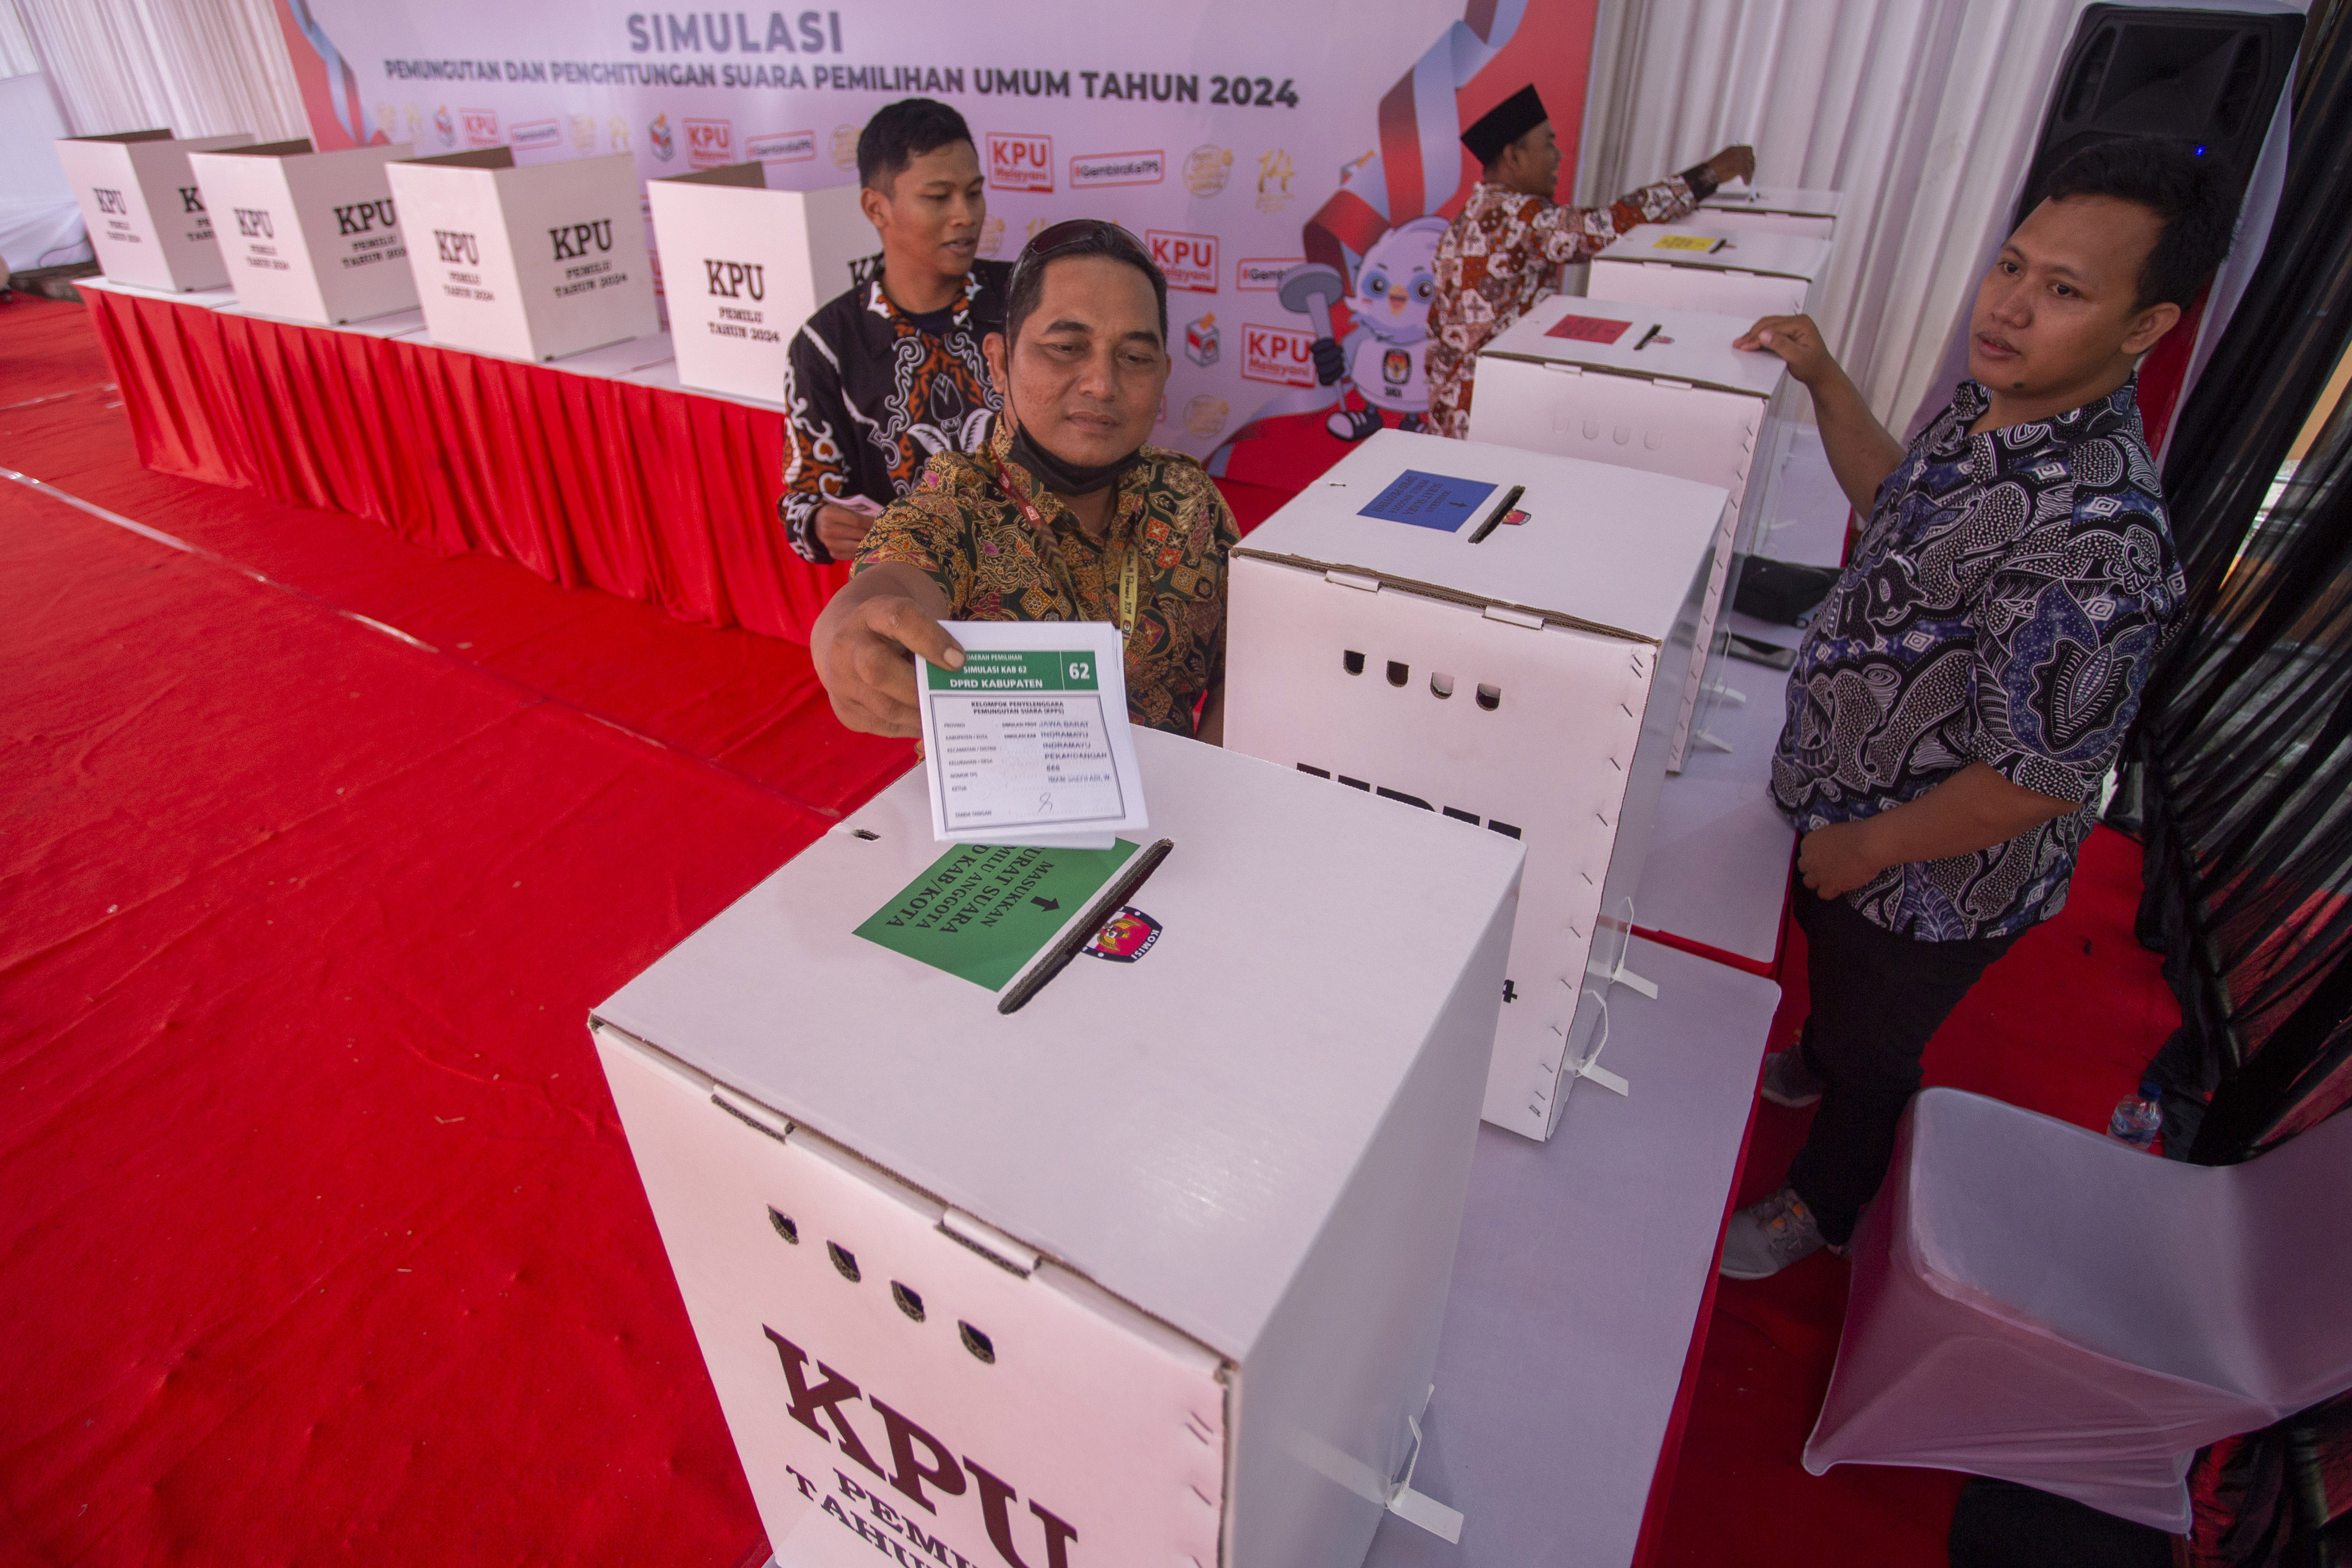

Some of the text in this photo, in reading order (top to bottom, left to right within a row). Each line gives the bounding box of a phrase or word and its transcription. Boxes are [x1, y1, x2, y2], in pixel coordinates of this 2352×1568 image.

[627, 11, 843, 53] SIMULASI
[385, 60, 1299, 108] PEMUNGUTAN DAN PENGHITUNGAN SUARA PEMILIHAN UMUM TAHUN 2024
[689, 126, 729, 148] KPU
[992, 141, 1047, 167] KPU
[1258, 147, 1295, 193] 14
[93, 187, 126, 215] KPU
[233, 208, 274, 239] KPU
[333, 198, 396, 236] KPU
[432, 229, 479, 266] KPU
[548, 218, 612, 262] KPU
[1152, 238, 1212, 267] KPU
[704, 258, 764, 301] KPU
[718, 306, 763, 324] PEMILU
[707, 321, 781, 343] TAHUN 2024
[1249, 331, 1311, 362] KPU
[950, 679, 1043, 688] DPRD KABUPATEN
[963, 665, 1027, 674] SIMULASI KAB 62
[1069, 662, 1090, 680] 62
[1039, 720, 1062, 728] JAWA
[1063, 720, 1088, 728] BARAT
[1044, 752, 1107, 760] PEKANDANGAN
[885, 855, 977, 926] KAB/KOTA
[916, 872, 982, 928] ANGGOTA
[980, 861, 1054, 927] MASUKKAN
[939, 886, 1000, 932] SUARA
[1131, 930, 1160, 959] KOMISI
[762, 1323, 1078, 1568] KPU
